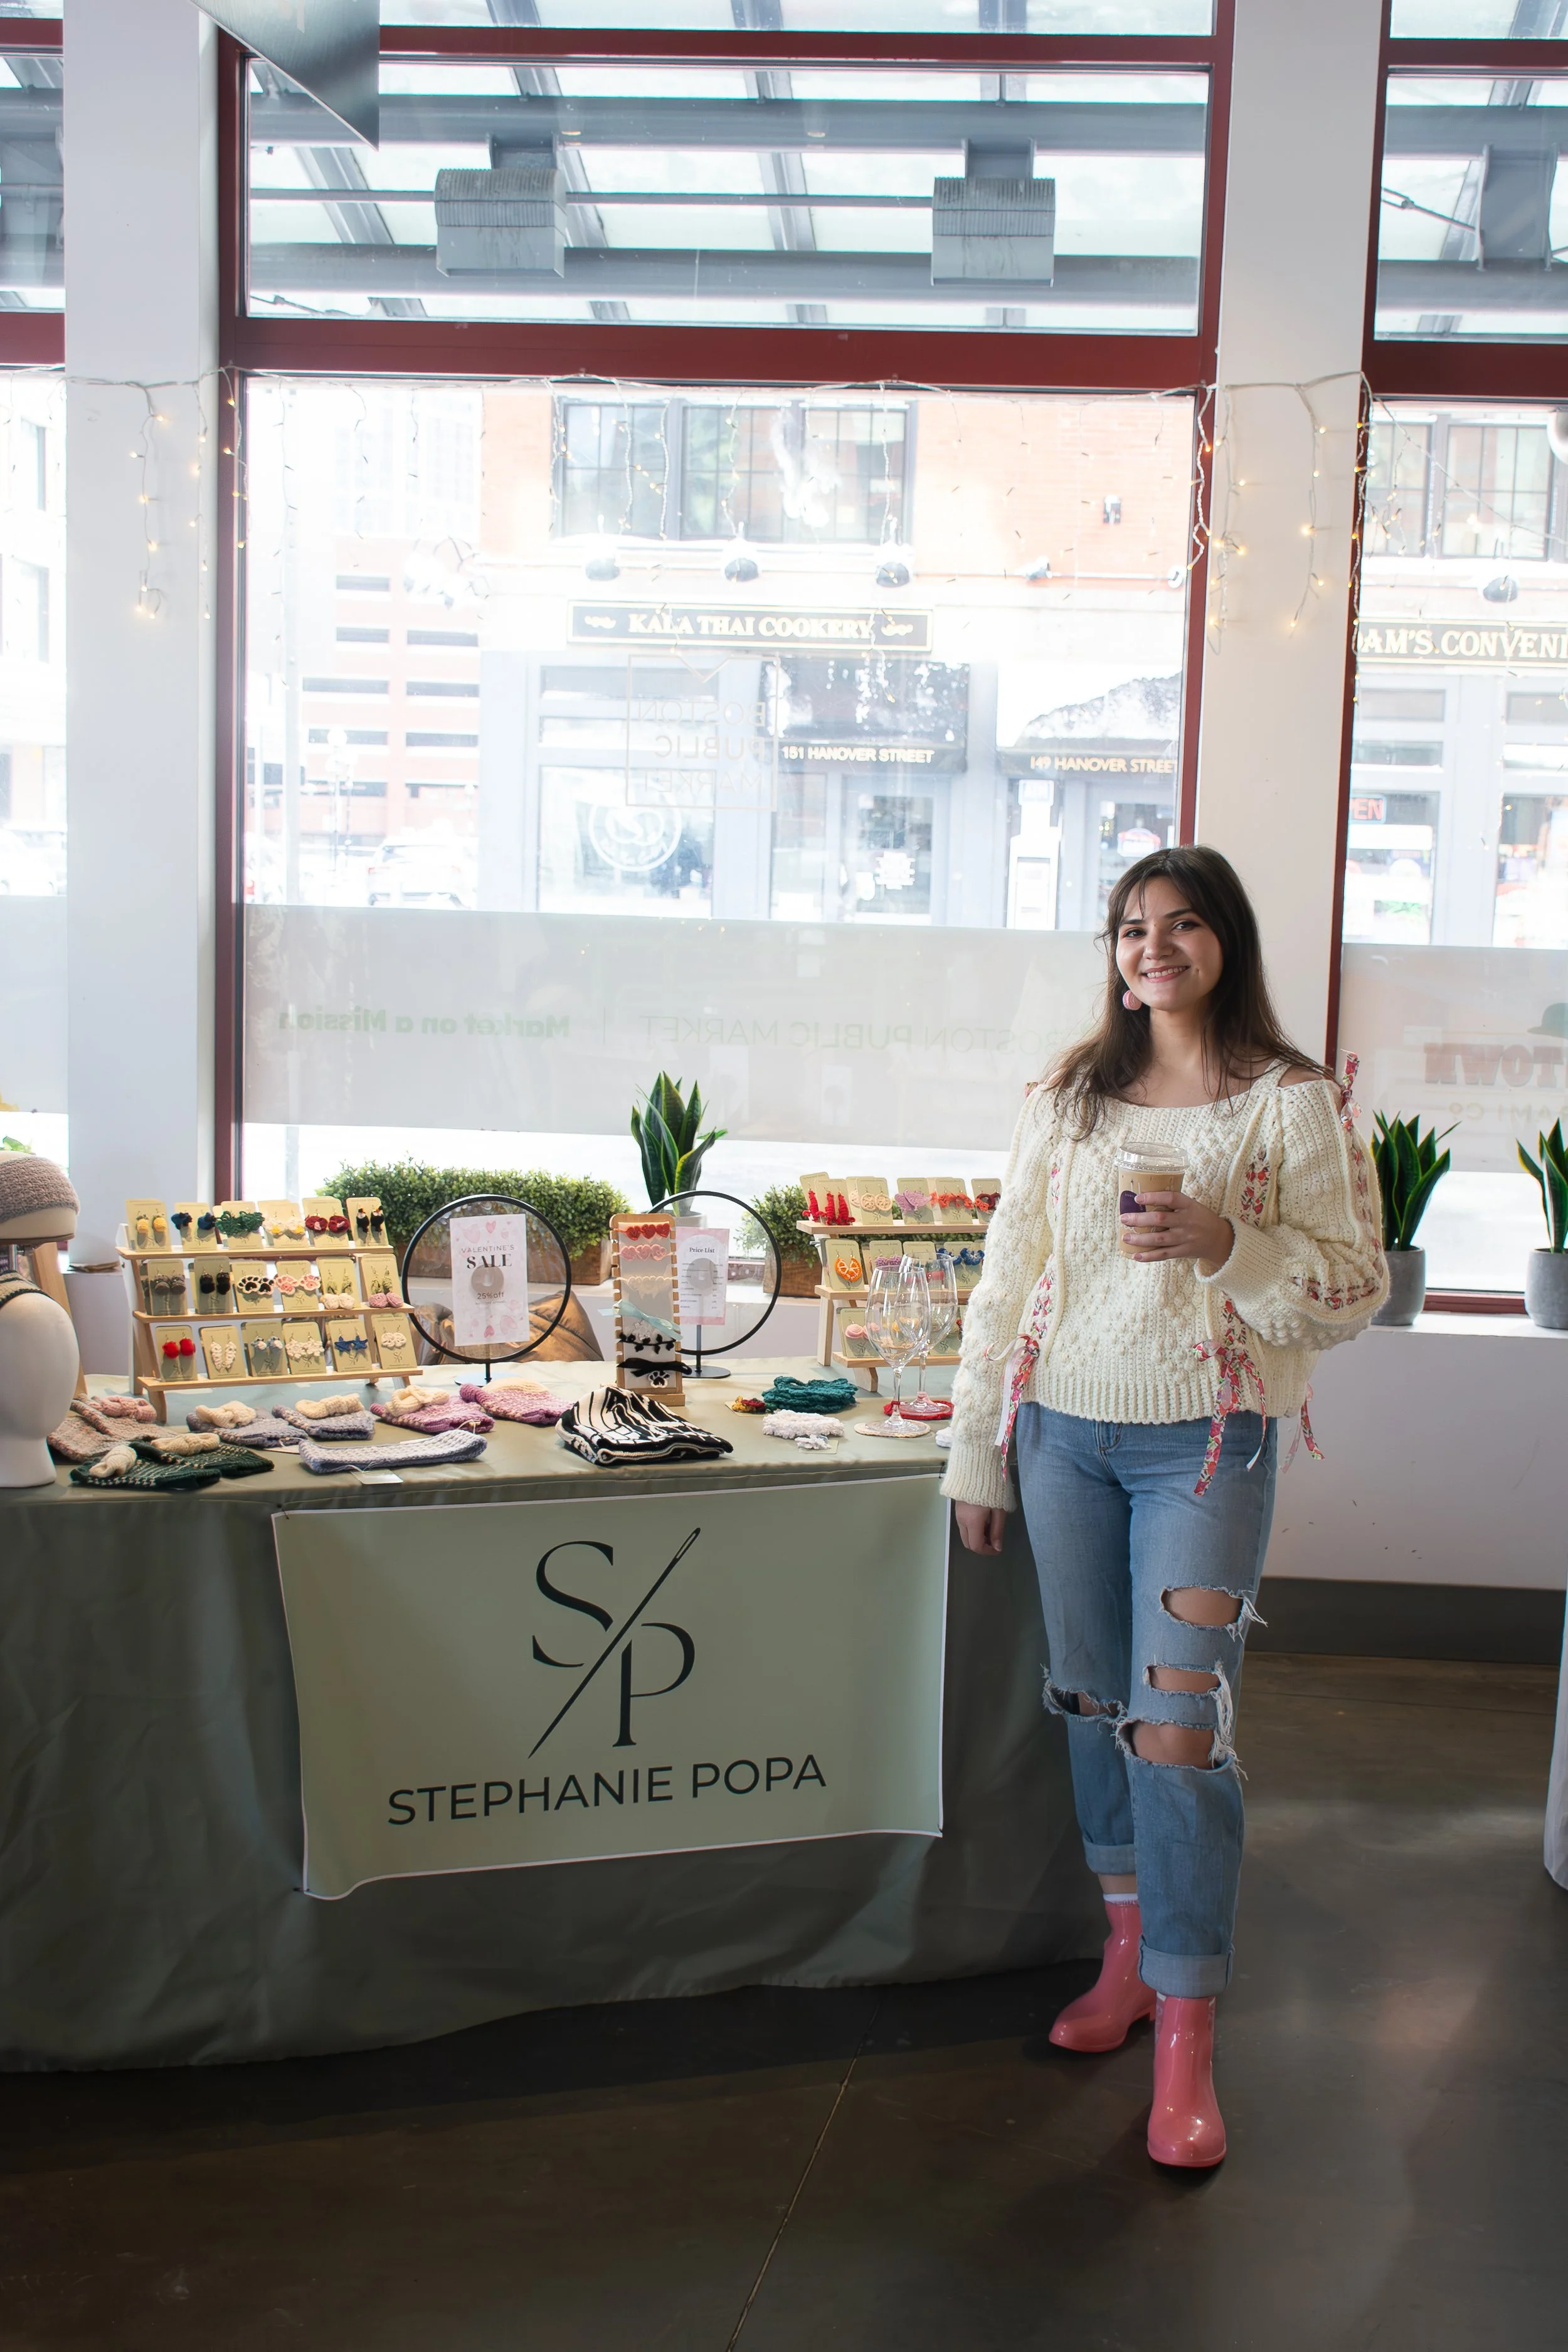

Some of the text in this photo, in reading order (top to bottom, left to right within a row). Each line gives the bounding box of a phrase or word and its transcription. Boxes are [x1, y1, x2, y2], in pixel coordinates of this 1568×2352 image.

[628, 613, 874, 639] KALA THAI COOKERY
[1441, 628, 1568, 659] CONVENI
[782, 746, 936, 764] 151 HANOVER STREET
[1054, 755, 1128, 773] HANOVER
[461, 1244, 515, 1253] VALENTINE'S
[467, 1253, 512, 1269] SALE
[388, 1754, 827, 1826] STEPHANIE POPA
